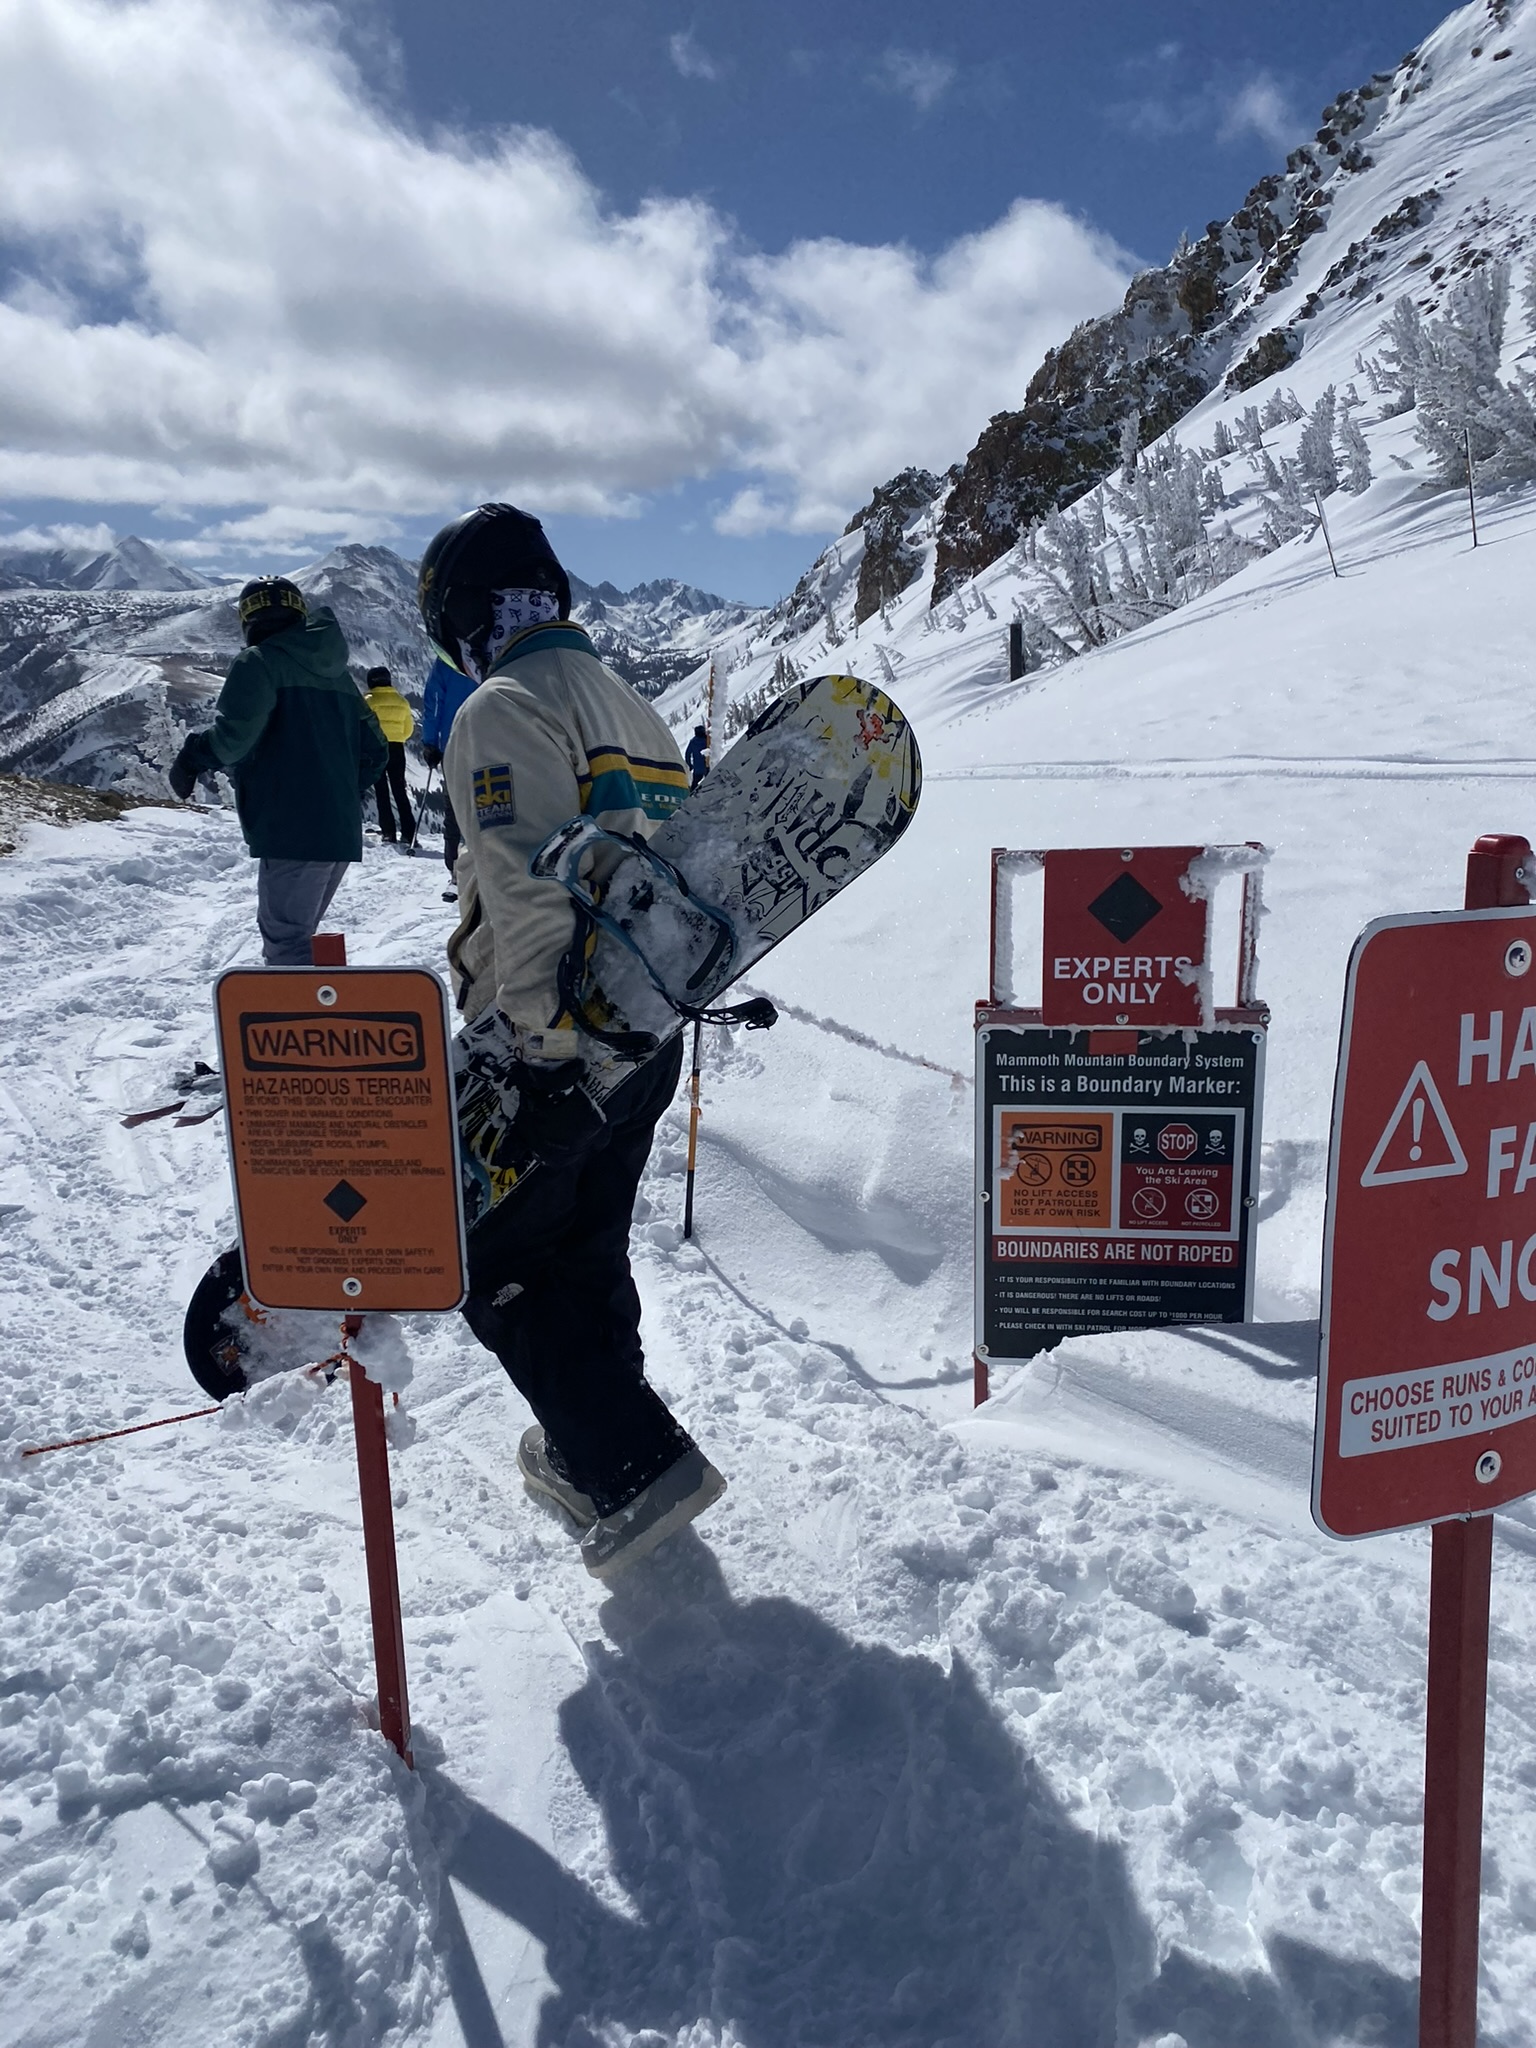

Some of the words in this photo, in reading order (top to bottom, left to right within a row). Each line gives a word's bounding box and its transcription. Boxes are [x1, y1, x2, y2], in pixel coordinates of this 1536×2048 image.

[1054, 957, 1193, 979] EXPERTS
[1082, 982, 1162, 1004] ONLY
[251, 1028, 414, 1056] WARNING
[996, 1054, 1060, 1067] Mammoth
[1064, 1054, 1125, 1067] Mountain
[1128, 1055, 1190, 1069] Boundary
[1195, 1055, 1244, 1069] System
[243, 1078, 350, 1095] HAZARDOUS
[356, 1078, 431, 1095] TERRAIN
[999, 1075, 1035, 1092] This
[1041, 1075, 1056, 1093] is
[1061, 1079, 1071, 1093] a
[1077, 1075, 1163, 1097] Boundary
[1169, 1076, 1241, 1094] Marker:
[244, 1096, 280, 1106] BEYOND
[282, 1096, 302, 1106] THIS
[305, 1096, 326, 1106] SIGN
[329, 1096, 348, 1106] YOU
[351, 1096, 372, 1106] WILL
[375, 1096, 432, 1106] ENCOUNTER
[309, 1110, 343, 1118] VARIABLE
[346, 1110, 393, 1118] CONDITIONS
[347, 1121, 381, 1129] NATURAL
[384, 1120, 428, 1129] OBSTACLES
[330, 1129, 361, 1137] TERRAIN
[1019, 1132, 1097, 1145] WARNING
[1161, 1133, 1194, 1150] STOP
[1136, 1166, 1154, 1175] You
[1158, 1167, 1175, 1175] Are
[1179, 1167, 1218, 1178] Leaving
[1145, 1176, 1160, 1184] the
[1165, 1176, 1180, 1184] Ski
[1184, 1177, 1208, 1185] Area
[1014, 1189, 1028, 1197] NO
[1032, 1189, 1052, 1197] LIFT
[1056, 1190, 1098, 1198] ACCESS
[1038, 1199, 1098, 1207] PATROLLED
[1010, 1208, 1030, 1216] USE
[1034, 1208, 1046, 1216] AT
[1049, 1208, 1073, 1216] OWN
[1077, 1209, 1100, 1217] RISK
[329, 1226, 367, 1236] EXPERTS
[338, 1236, 358, 1244] ONLY
[365, 1248, 383, 1256] YOUR
[997, 1241, 1099, 1259] BOUNDARIES
[1104, 1243, 1135, 1260] ARE
[1141, 1244, 1173, 1261] NOT
[1178, 1245, 1233, 1263] ROPED
[1198, 1281, 1236, 1289] LOCATIONS
[1350, 1380, 1435, 1416] CHOOSE
[1443, 1368, 1491, 1399] RUNS
[1498, 1369, 1506, 1387] &
[1513, 1356, 1536, 1382] CO
[1371, 1410, 1441, 1443] SUITED
[1449, 1403, 1472, 1427] TO
[1480, 1389, 1523, 1421] YOUR
